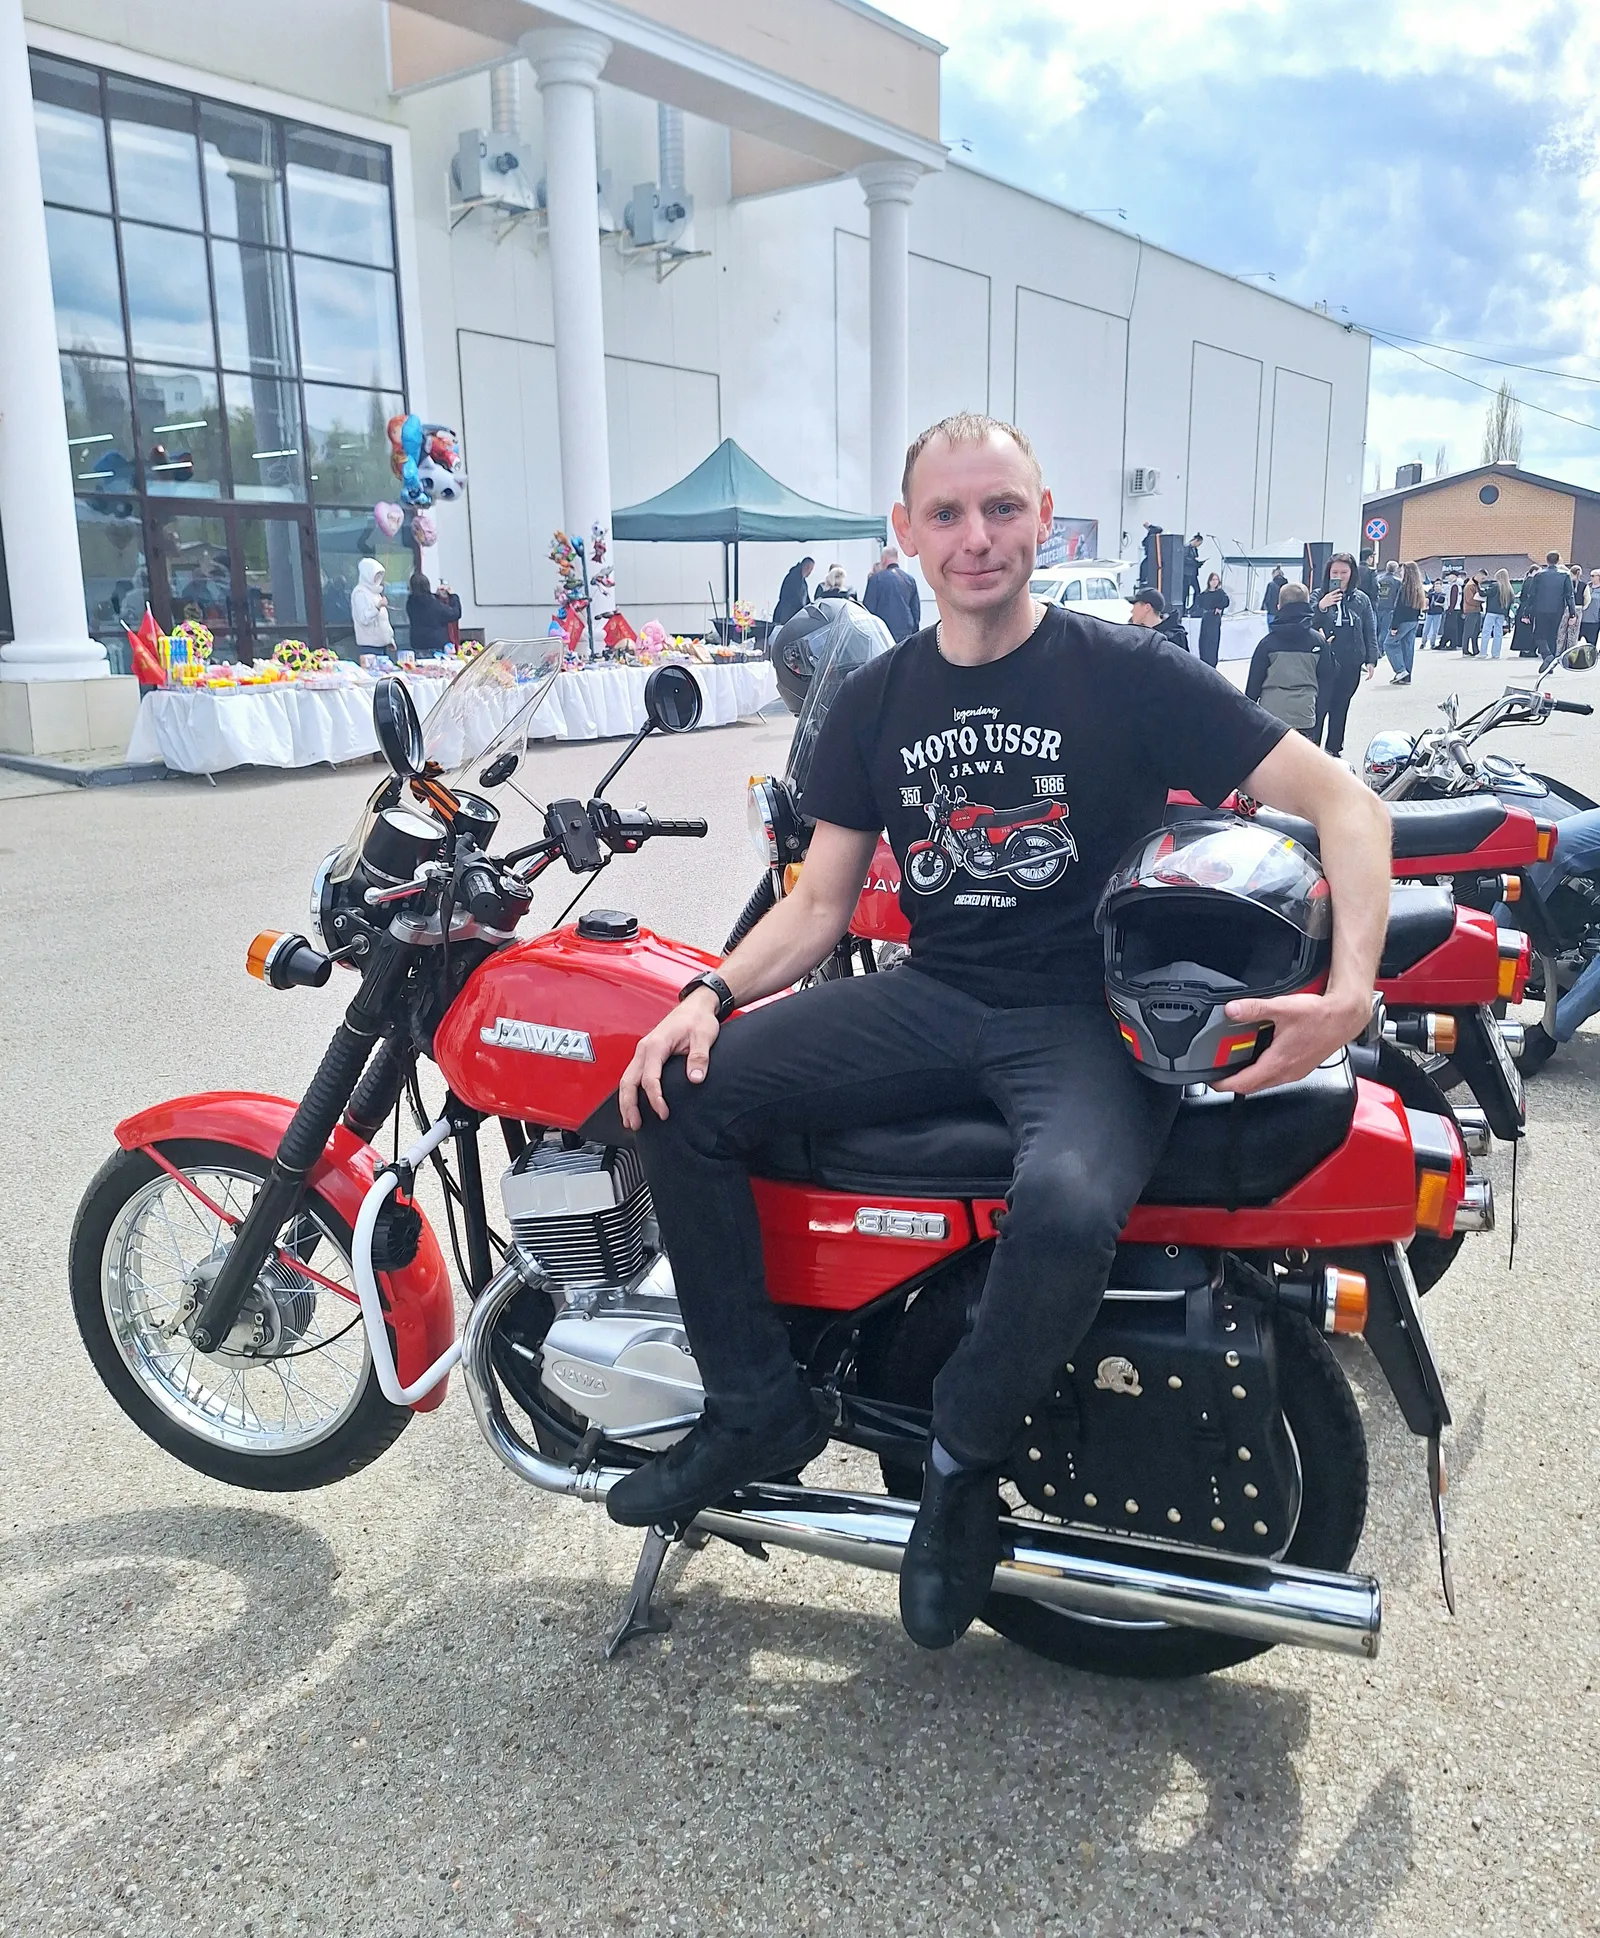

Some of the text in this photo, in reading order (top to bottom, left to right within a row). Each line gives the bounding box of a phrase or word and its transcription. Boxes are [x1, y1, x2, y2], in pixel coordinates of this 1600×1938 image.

[900, 723, 1063, 775] MOTO USSR
[949, 760, 1005, 778] JAWA
[901, 788, 922, 805] 350
[1034, 777, 1065, 794] 1986
[953, 894, 1017, 908] CHECKED BY YEARS
[480, 1016, 597, 1063] JAWA
[855, 1207, 949, 1240] 350
[556, 1366, 608, 1393] JAWA
